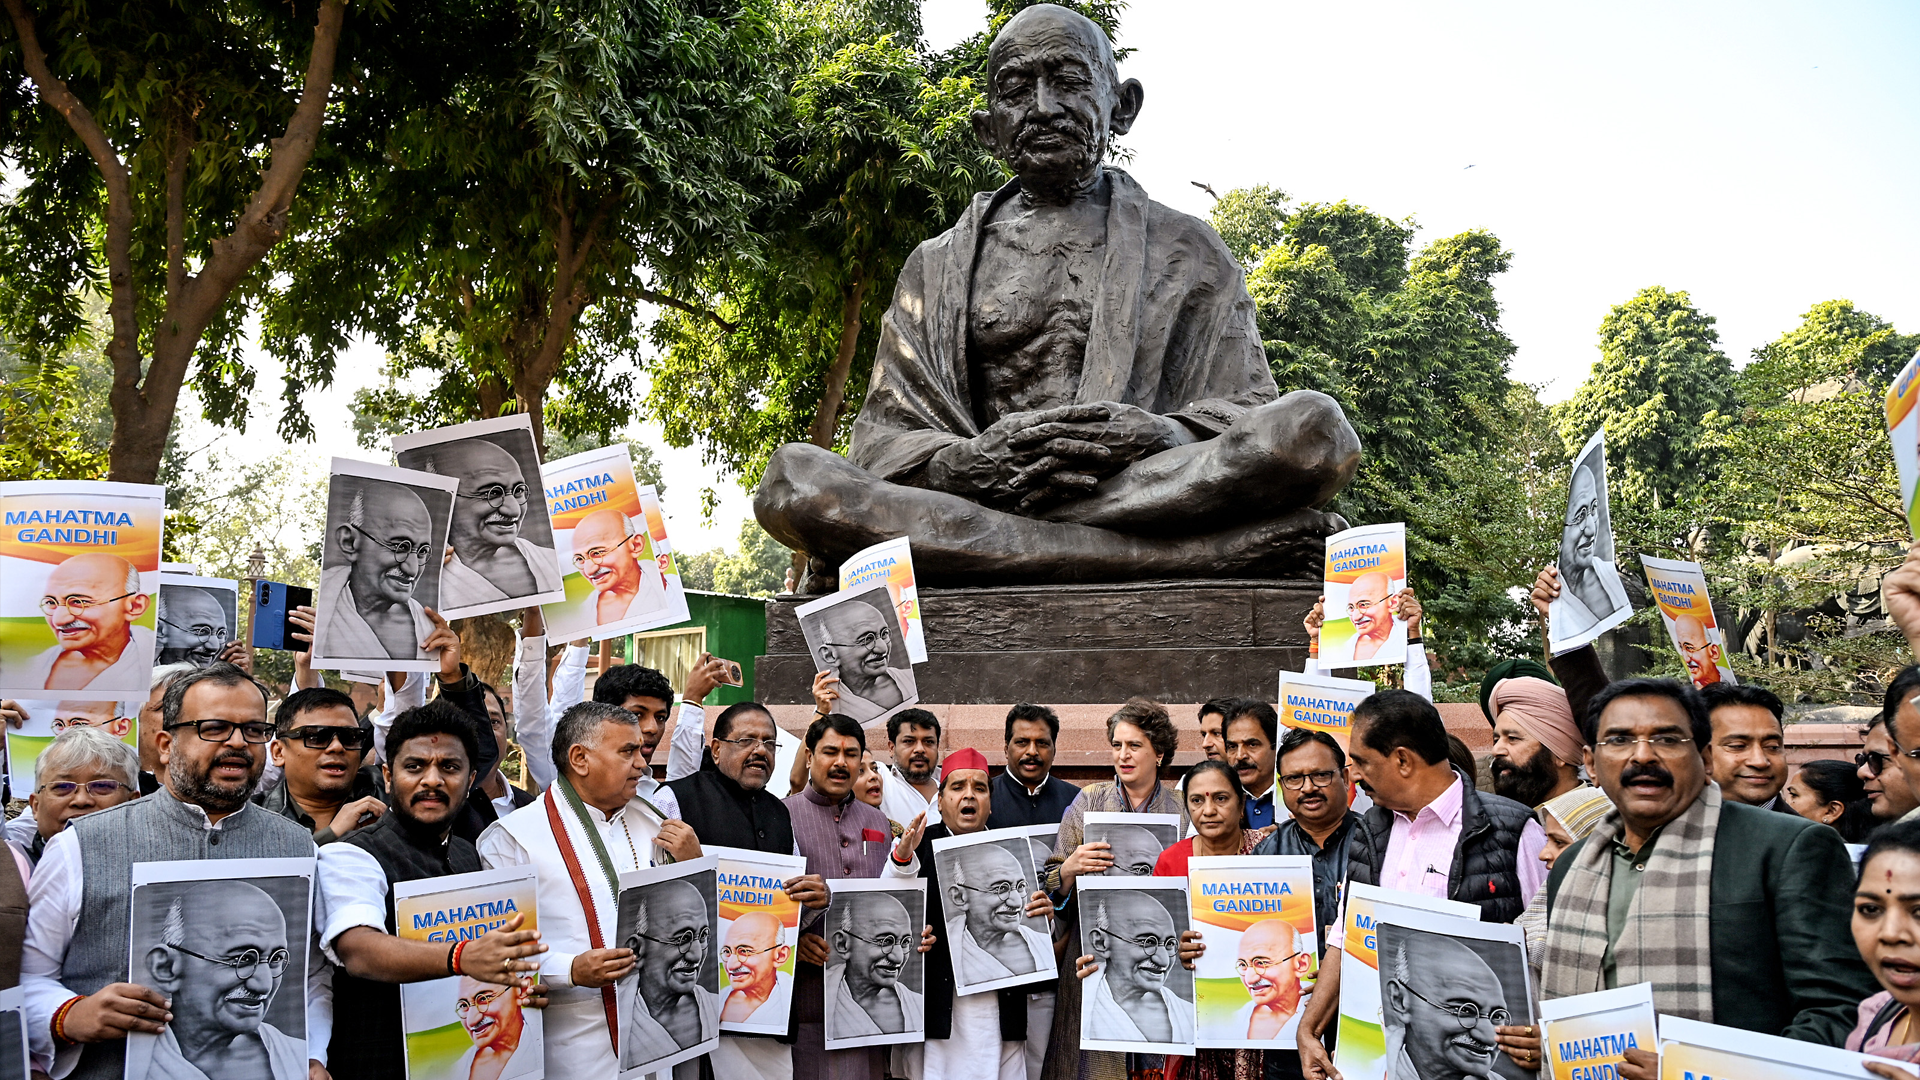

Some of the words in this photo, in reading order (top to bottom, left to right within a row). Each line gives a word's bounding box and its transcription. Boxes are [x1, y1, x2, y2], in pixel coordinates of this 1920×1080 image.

[545, 473, 616, 499] AHATMA
[548, 490, 610, 515] ANDHI
[5, 509, 134, 527] MAHATMA
[17, 528, 118, 545] GANDHI
[1330, 543, 1389, 562] MAHATMA
[844, 557, 897, 584] MAHATMA
[1333, 557, 1380, 573] GANDHI
[1651, 577, 1697, 596] MAHATMA
[1658, 592, 1693, 609] GANDHI
[1287, 694, 1356, 713] MAHATMA
[1293, 710, 1348, 727] GANDHI
[718, 872, 784, 891] AHATMA
[1202, 882, 1293, 896] MAHATMA
[718, 888, 774, 906] ANDHI
[1213, 899, 1283, 913] GANDHI
[413, 898, 518, 930] MAHATMA
[1559, 1032, 1639, 1064] MAHATMA
[1571, 1063, 1630, 1080] GAND
